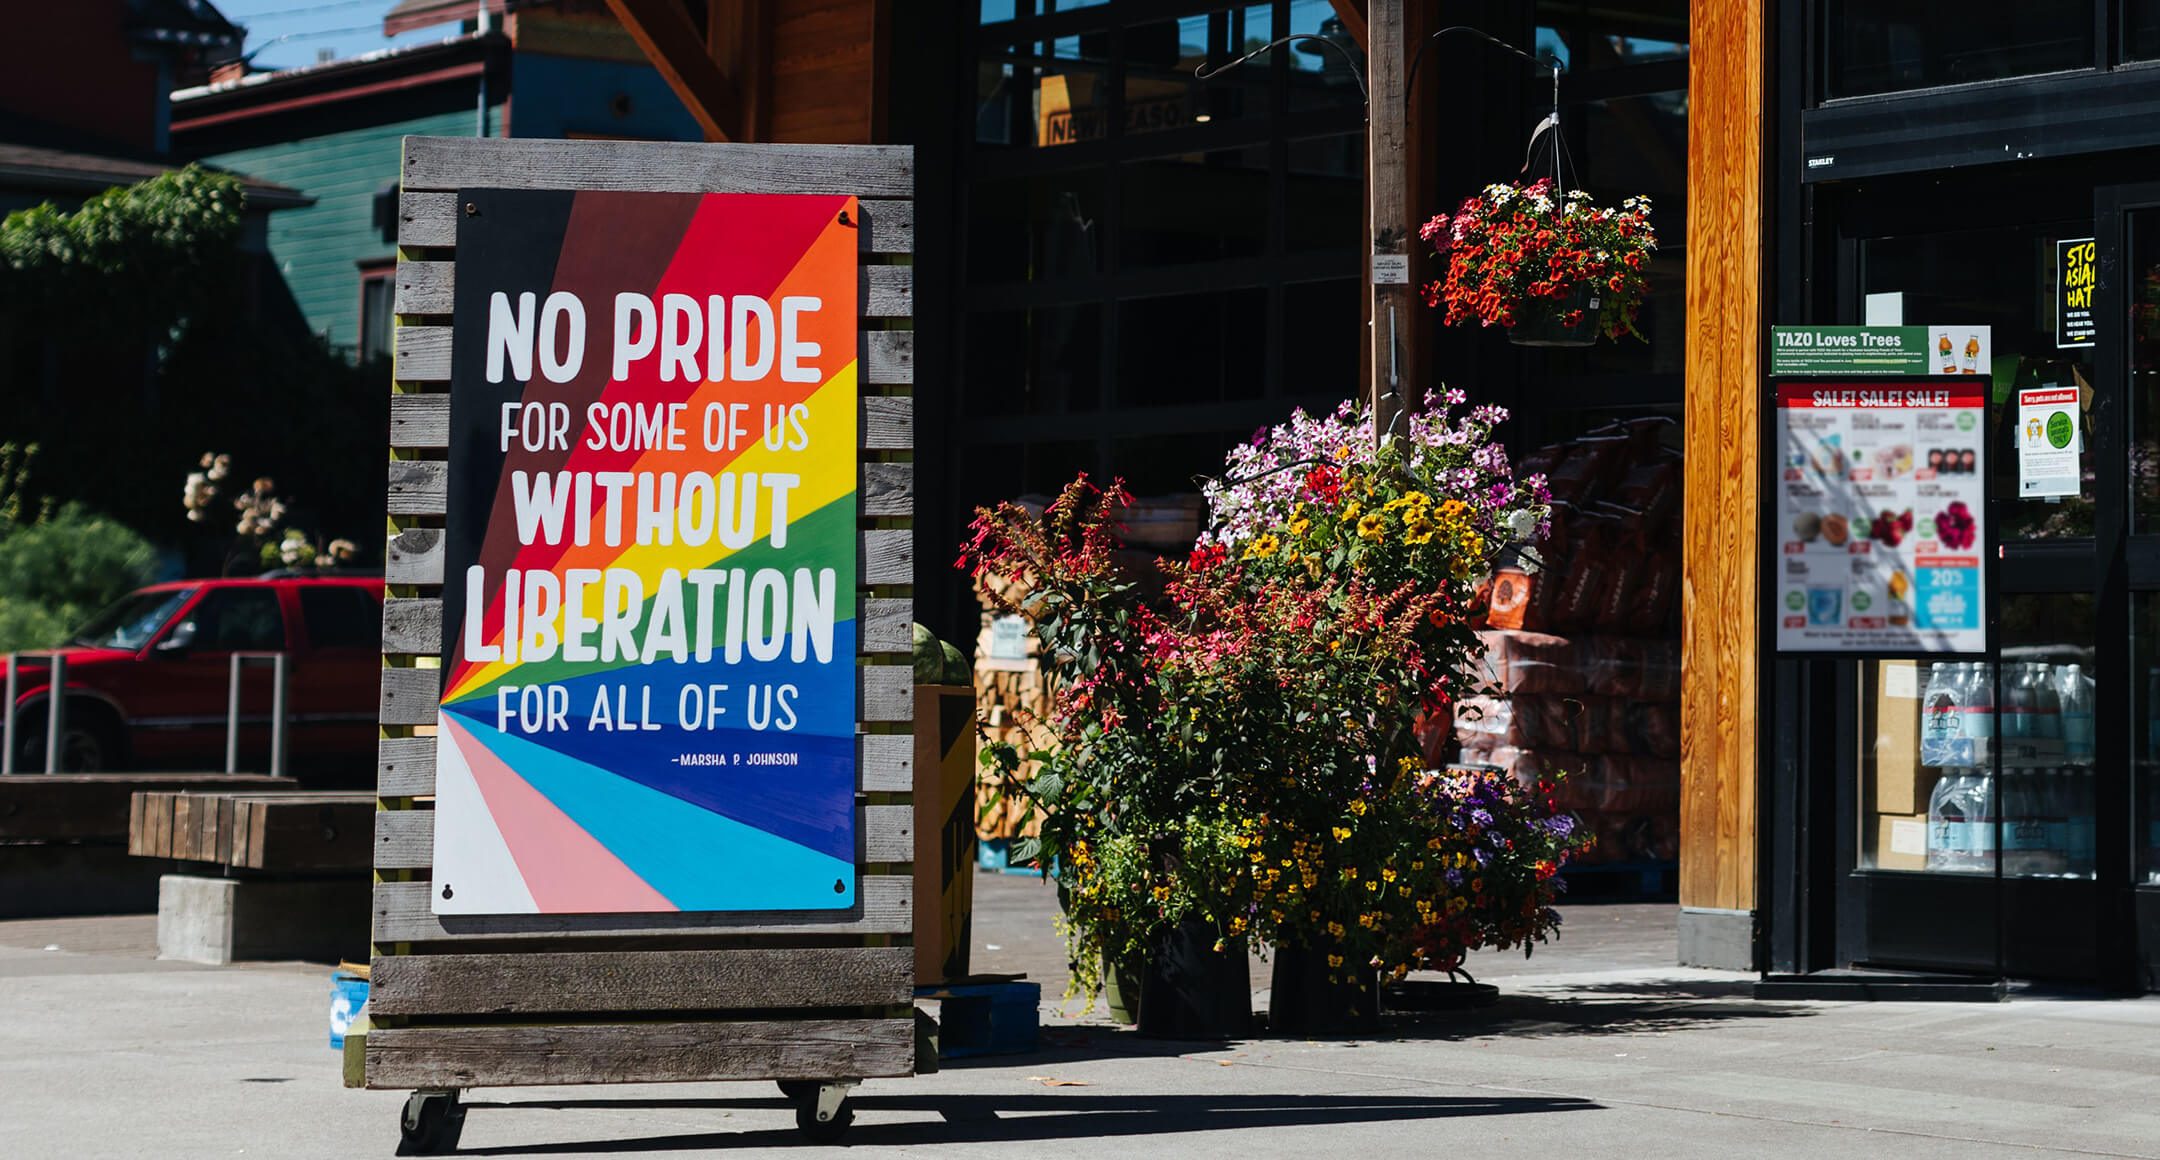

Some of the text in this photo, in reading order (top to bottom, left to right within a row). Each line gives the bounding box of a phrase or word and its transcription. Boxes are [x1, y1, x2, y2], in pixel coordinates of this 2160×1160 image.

[1808, 157, 1834, 168] STANLEY
[2067, 242, 2095, 267] STO
[2067, 285, 2095, 308] HAT
[487, 292, 822, 383] NO PRIDE
[1777, 333, 1901, 347] TAZO Loves Trees
[1812, 390, 1950, 407] SALE! SALE! SALE!
[502, 402, 810, 452] FOR SOME OF US
[511, 471, 801, 549] WITHOUT
[464, 565, 836, 665] LIBERATION
[498, 684, 798, 733] FOR ALL OF US
[746, 753, 798, 765] JOHNSON
